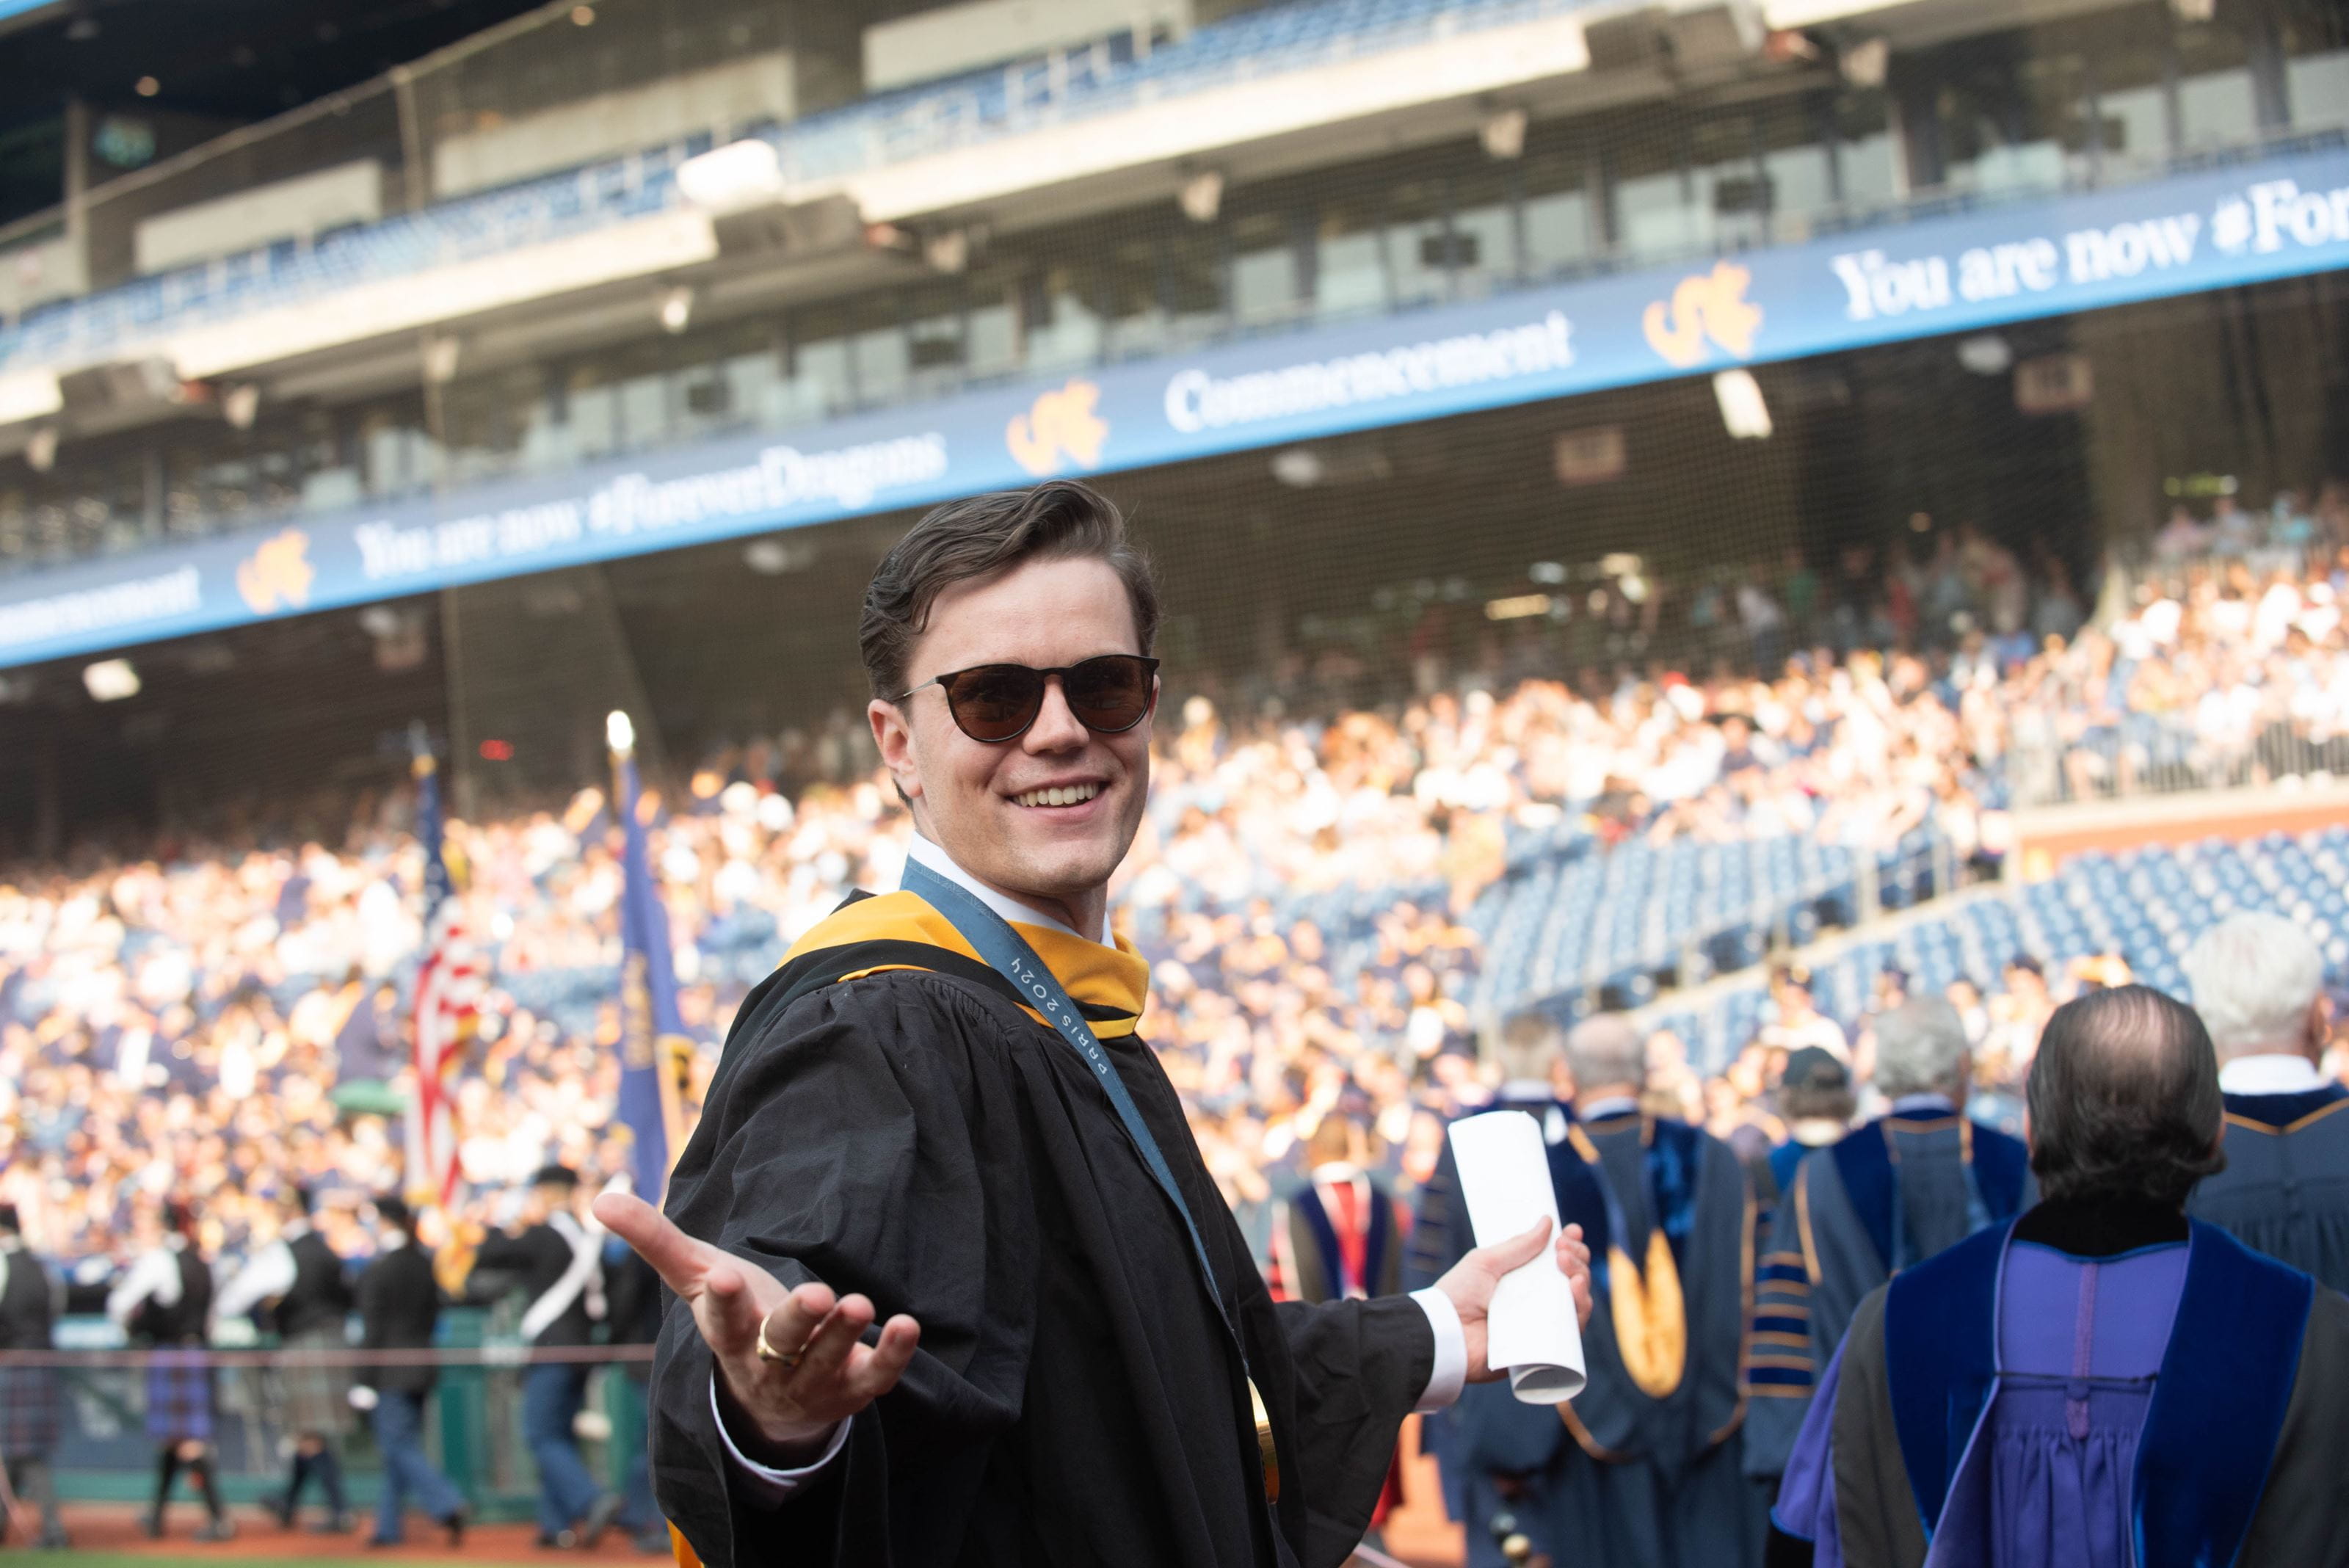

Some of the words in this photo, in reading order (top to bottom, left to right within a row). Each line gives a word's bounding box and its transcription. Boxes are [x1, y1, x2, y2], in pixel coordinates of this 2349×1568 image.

[1830, 247, 1949, 321] You
[1957, 236, 2058, 302] are
[2061, 211, 2200, 285] now
[1010, 957, 1061, 1012] 2024
[1061, 1014, 1108, 1075] PARIS
